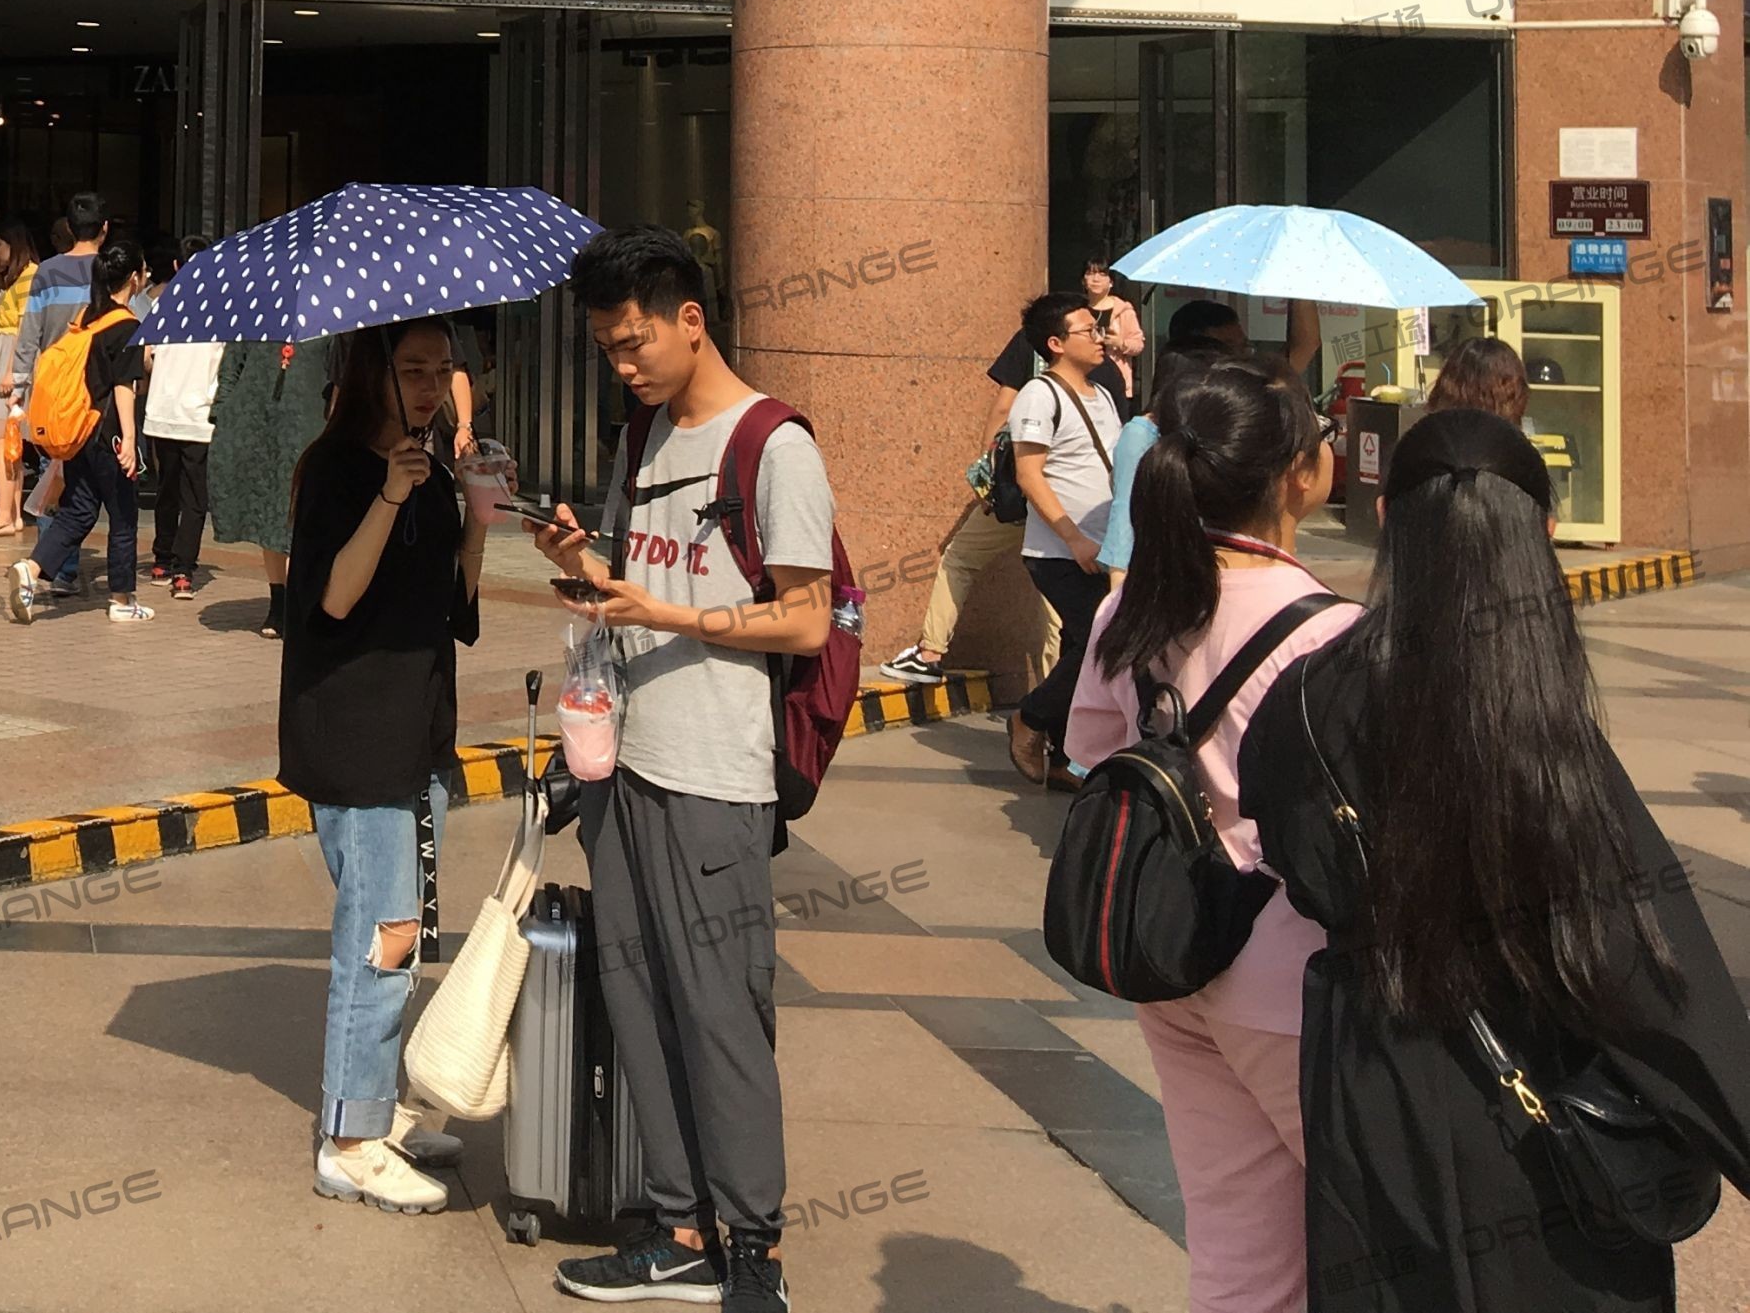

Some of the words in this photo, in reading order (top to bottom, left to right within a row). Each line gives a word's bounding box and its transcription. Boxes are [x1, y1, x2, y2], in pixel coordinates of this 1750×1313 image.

[1572, 187, 1628, 200] 营业时间
[1571, 201, 1606, 209] Business
[1558, 220, 1592, 229] 09:00
[1608, 220, 1642, 230] 23:00
[1576, 244, 1624, 254] 退税商店
[1576, 256, 1595, 265] TAX
[647, 535, 679, 569] DO
